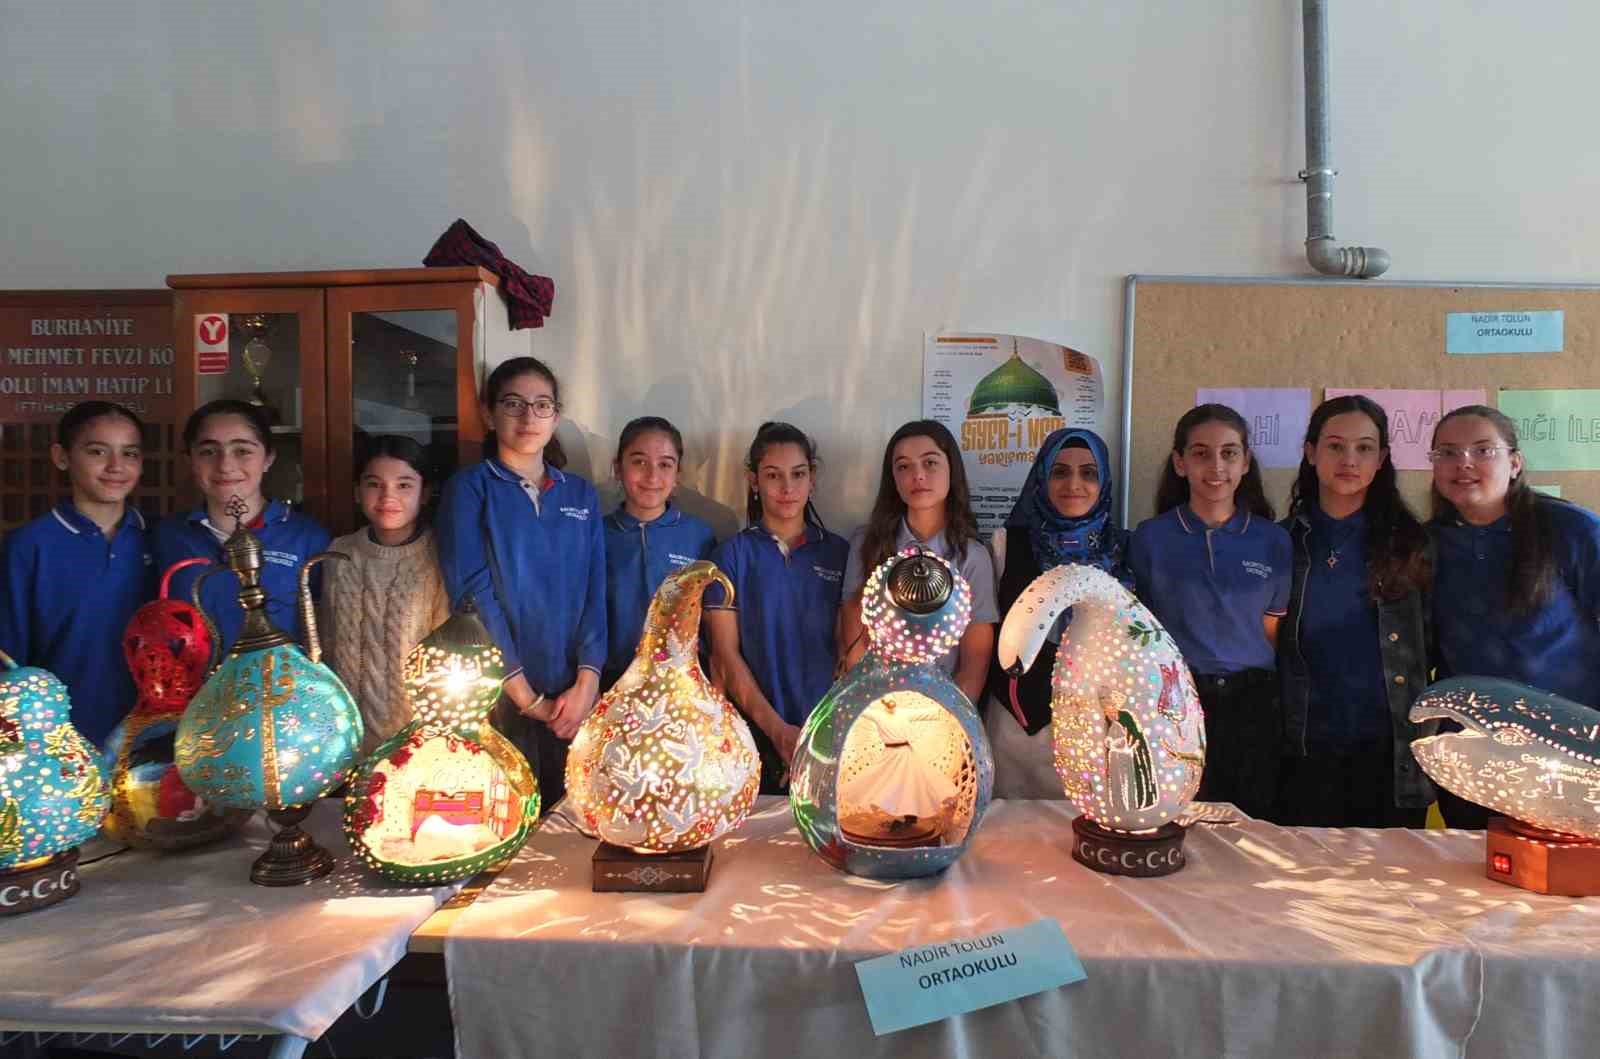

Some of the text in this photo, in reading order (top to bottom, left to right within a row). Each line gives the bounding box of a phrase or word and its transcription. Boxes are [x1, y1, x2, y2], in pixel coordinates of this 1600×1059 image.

[31, 313, 135, 336] BURHANİYE
[1501, 313, 1531, 323] TOLUN
[1476, 328, 1533, 337] ORTAOKULU
[7, 347, 85, 365] MEHMET
[42, 371, 89, 394] İMAM
[900, 934, 1006, 969] NADİR TOLUN
[919, 952, 1018, 990] ORTAOKULU
